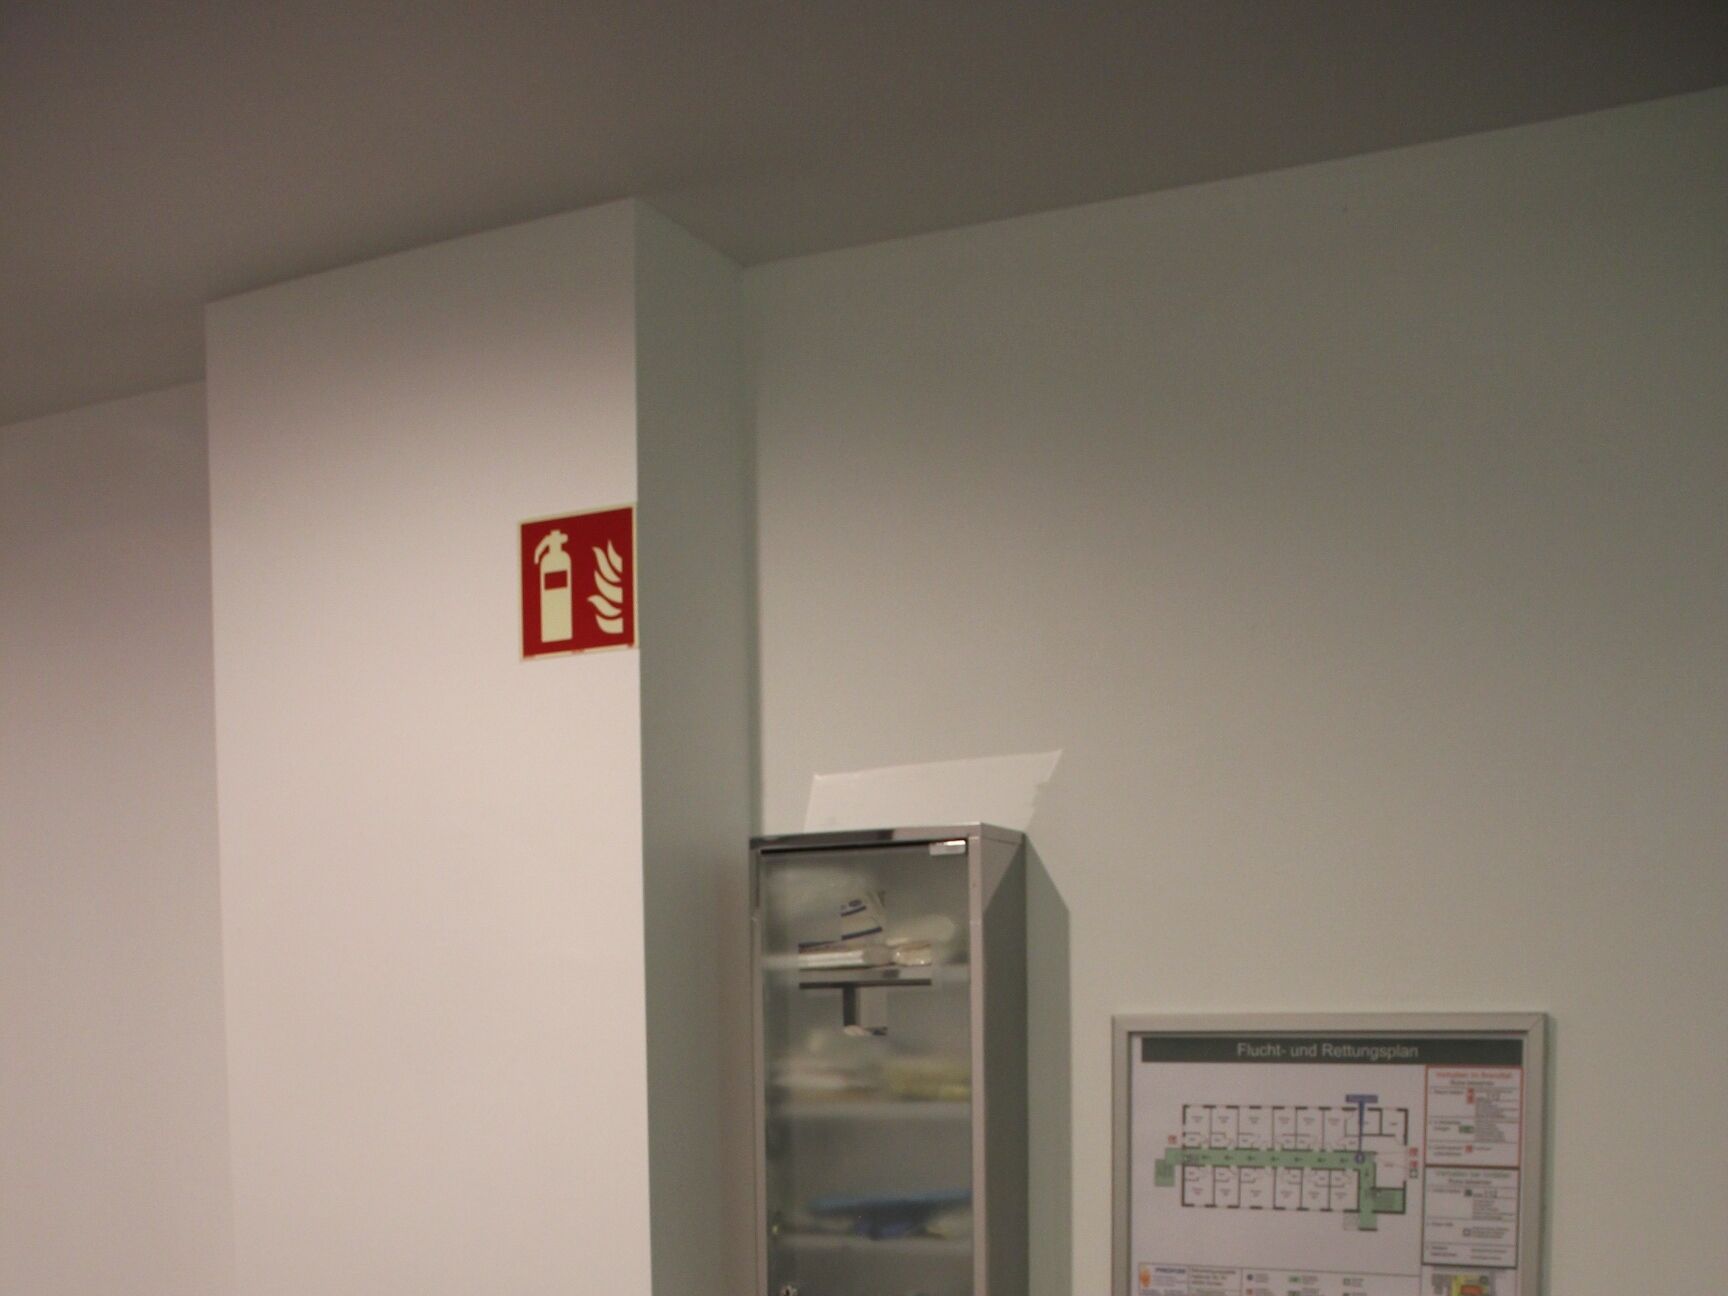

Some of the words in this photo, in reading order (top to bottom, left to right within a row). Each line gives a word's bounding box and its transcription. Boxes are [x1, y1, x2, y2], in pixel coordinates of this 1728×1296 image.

[1237, 1042, 1286, 1057] Flucht-
[1290, 1043, 1318, 1058] und
[1322, 1042, 1420, 1061] Rettungsplan
